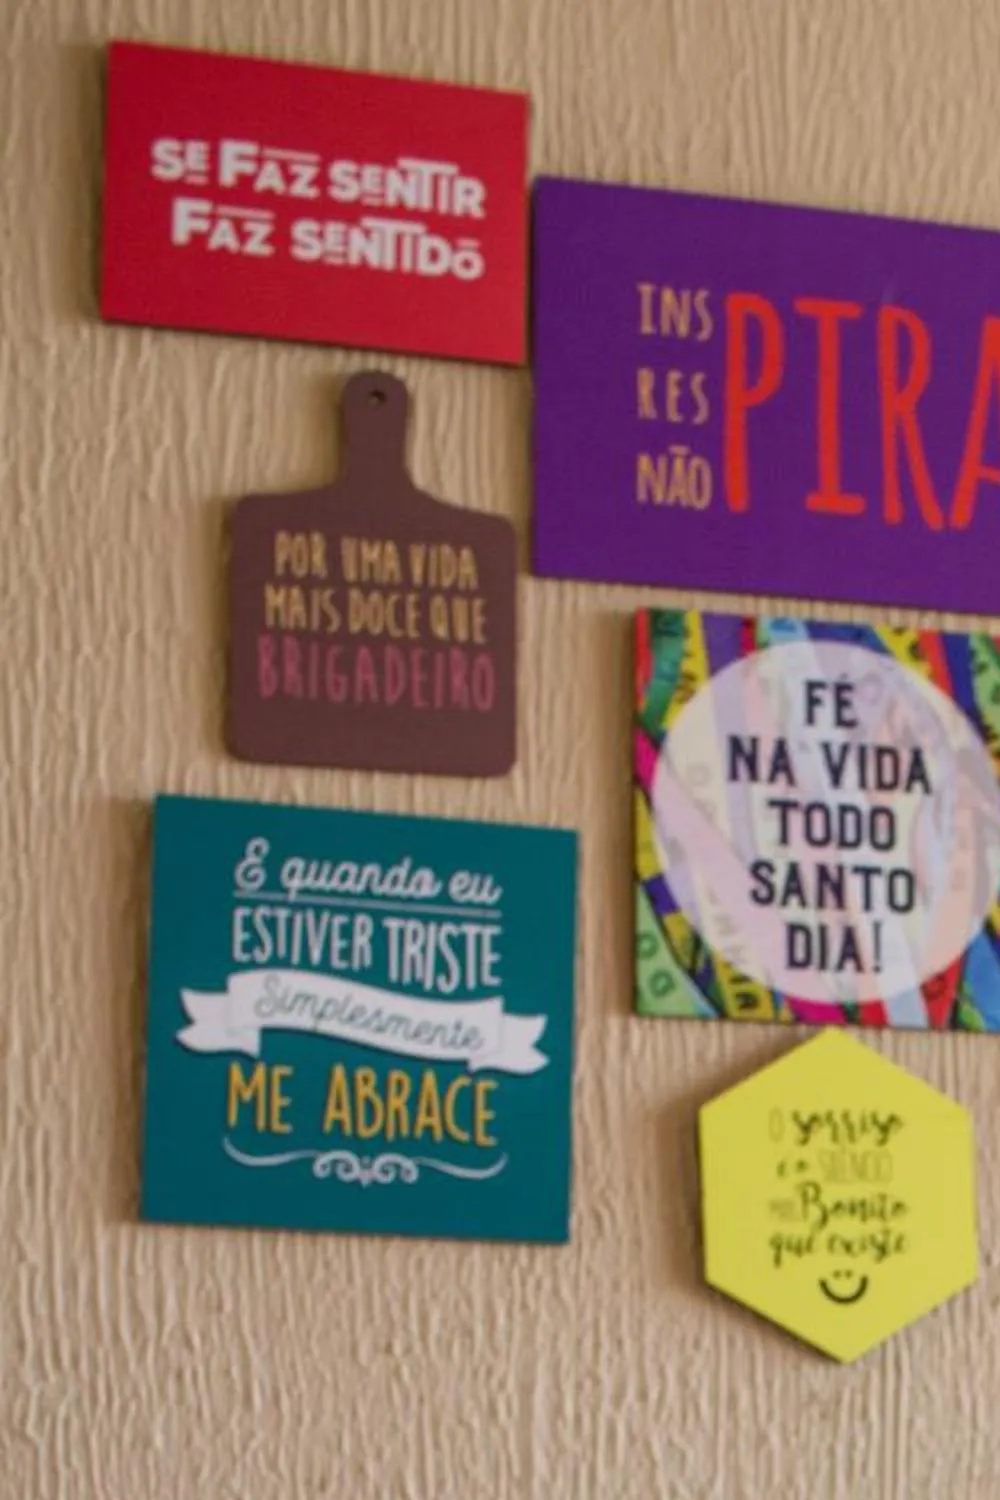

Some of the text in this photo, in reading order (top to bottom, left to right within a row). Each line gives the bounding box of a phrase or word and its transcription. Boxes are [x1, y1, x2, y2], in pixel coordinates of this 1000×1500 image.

[218, 139, 321, 200] FAZ
[328, 156, 487, 219] SENTIR
[171, 197, 275, 257] FAZ
[638, 283, 714, 341] INS
[637, 368, 709, 424] RES
[636, 445, 713, 510] NÃO
[274, 530, 479, 590] POR UMA VIDA
[264, 582, 488, 645] MAIS DOCE QUE
[257, 633, 497, 713] BRIGADEIRO
[804, 673, 858, 728] FÉ
[728, 736, 932, 795] NA VIDA
[767, 799, 897, 852] TODO
[234, 836, 502, 904] E quando eu
[749, 861, 915, 913] SANTO
[231, 906, 503, 993] ESTIVER TRISTE
[786, 922, 884, 973] DIA!
[253, 975, 486, 1053] Simplesmente
[227, 1062, 500, 1148] ME ABRACE
